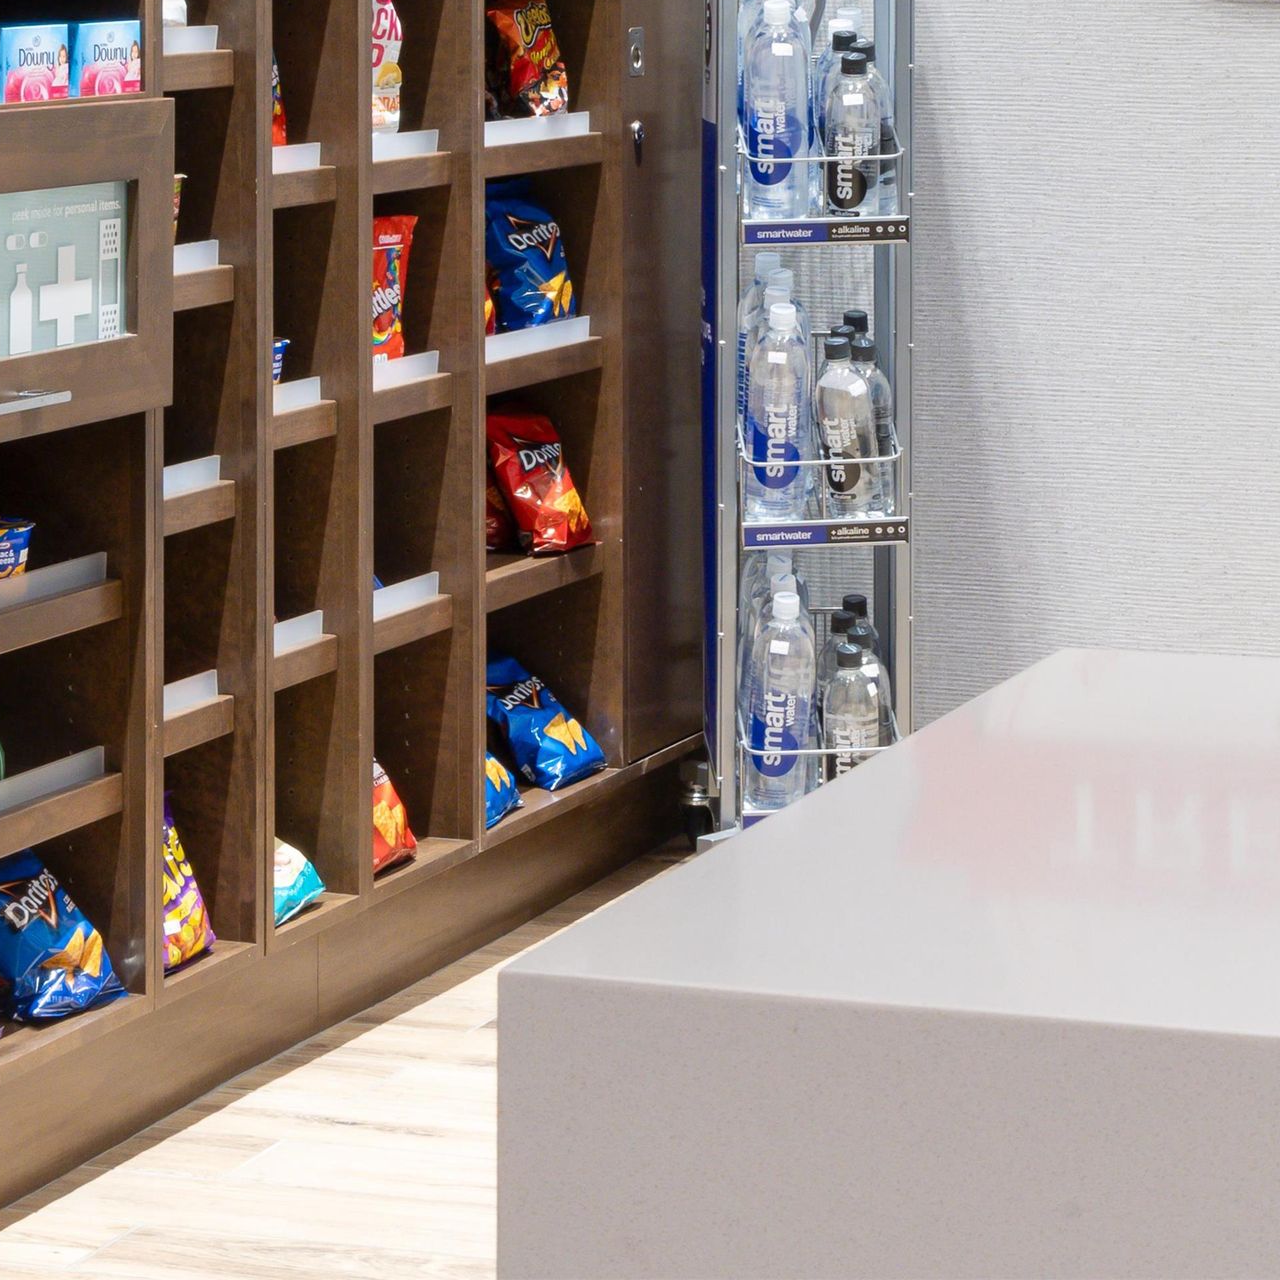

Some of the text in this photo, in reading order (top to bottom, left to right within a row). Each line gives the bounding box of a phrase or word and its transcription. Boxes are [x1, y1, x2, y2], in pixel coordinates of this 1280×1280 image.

[18, 48, 55, 70] Downy
[94, 43, 128, 66] Downy
[776, 102, 786, 134] water
[756, 100, 777, 174] smart
[835, 133, 855, 200] smart
[509, 222, 560, 250] Dorito
[757, 229, 813, 239] smartwater
[787, 404, 798, 437] water
[840, 418, 852, 447] water
[520, 441, 562, 472] Dorit
[765, 404, 788, 478] smart
[823, 418, 846, 483] smart
[756, 531, 812, 541] smartwater
[785, 694, 797, 726] water
[763, 692, 786, 767] smart
[833, 727, 852, 777] mart
[4, 868, 59, 929] Doritos
